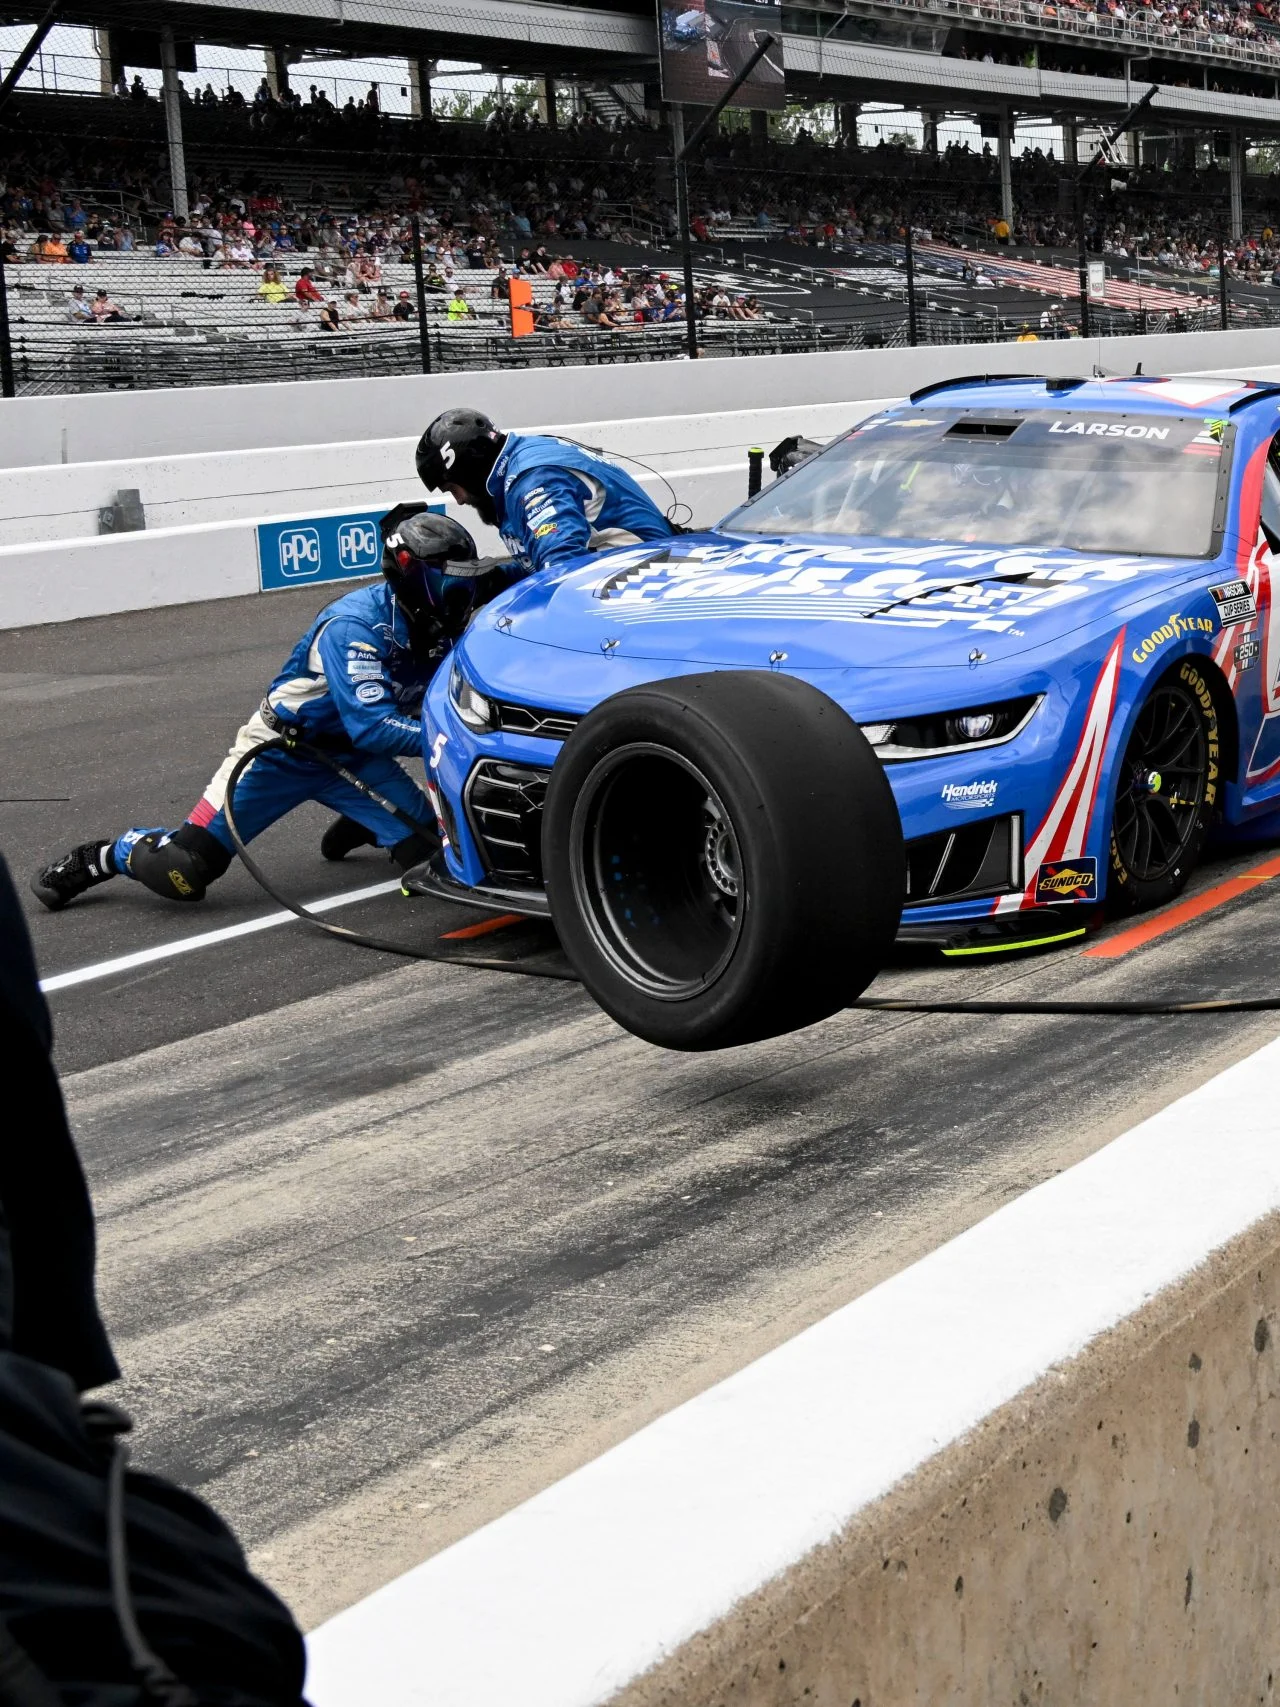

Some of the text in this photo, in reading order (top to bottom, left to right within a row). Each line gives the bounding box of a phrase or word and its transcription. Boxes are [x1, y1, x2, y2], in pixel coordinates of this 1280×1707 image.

[1048, 421, 1170, 440] LARSON
[440, 441, 456, 470] 5
[340, 527, 376, 563] PPG
[386, 532, 405, 549] 5
[281, 534, 319, 571] PPG
[1222, 583, 1246, 598] NASCAR
[1223, 599, 1251, 618] CUP SERIES
[1131, 612, 1214, 664] GOODYEAR
[1239, 641, 1255, 660] 250
[1179, 662, 1220, 806] GOODYEAR
[430, 732, 448, 768] 5
[941, 779, 999, 802] Hendrick
[950, 793, 996, 802] MOTORSPORTS
[1041, 874, 1092, 890] SUNOCO
